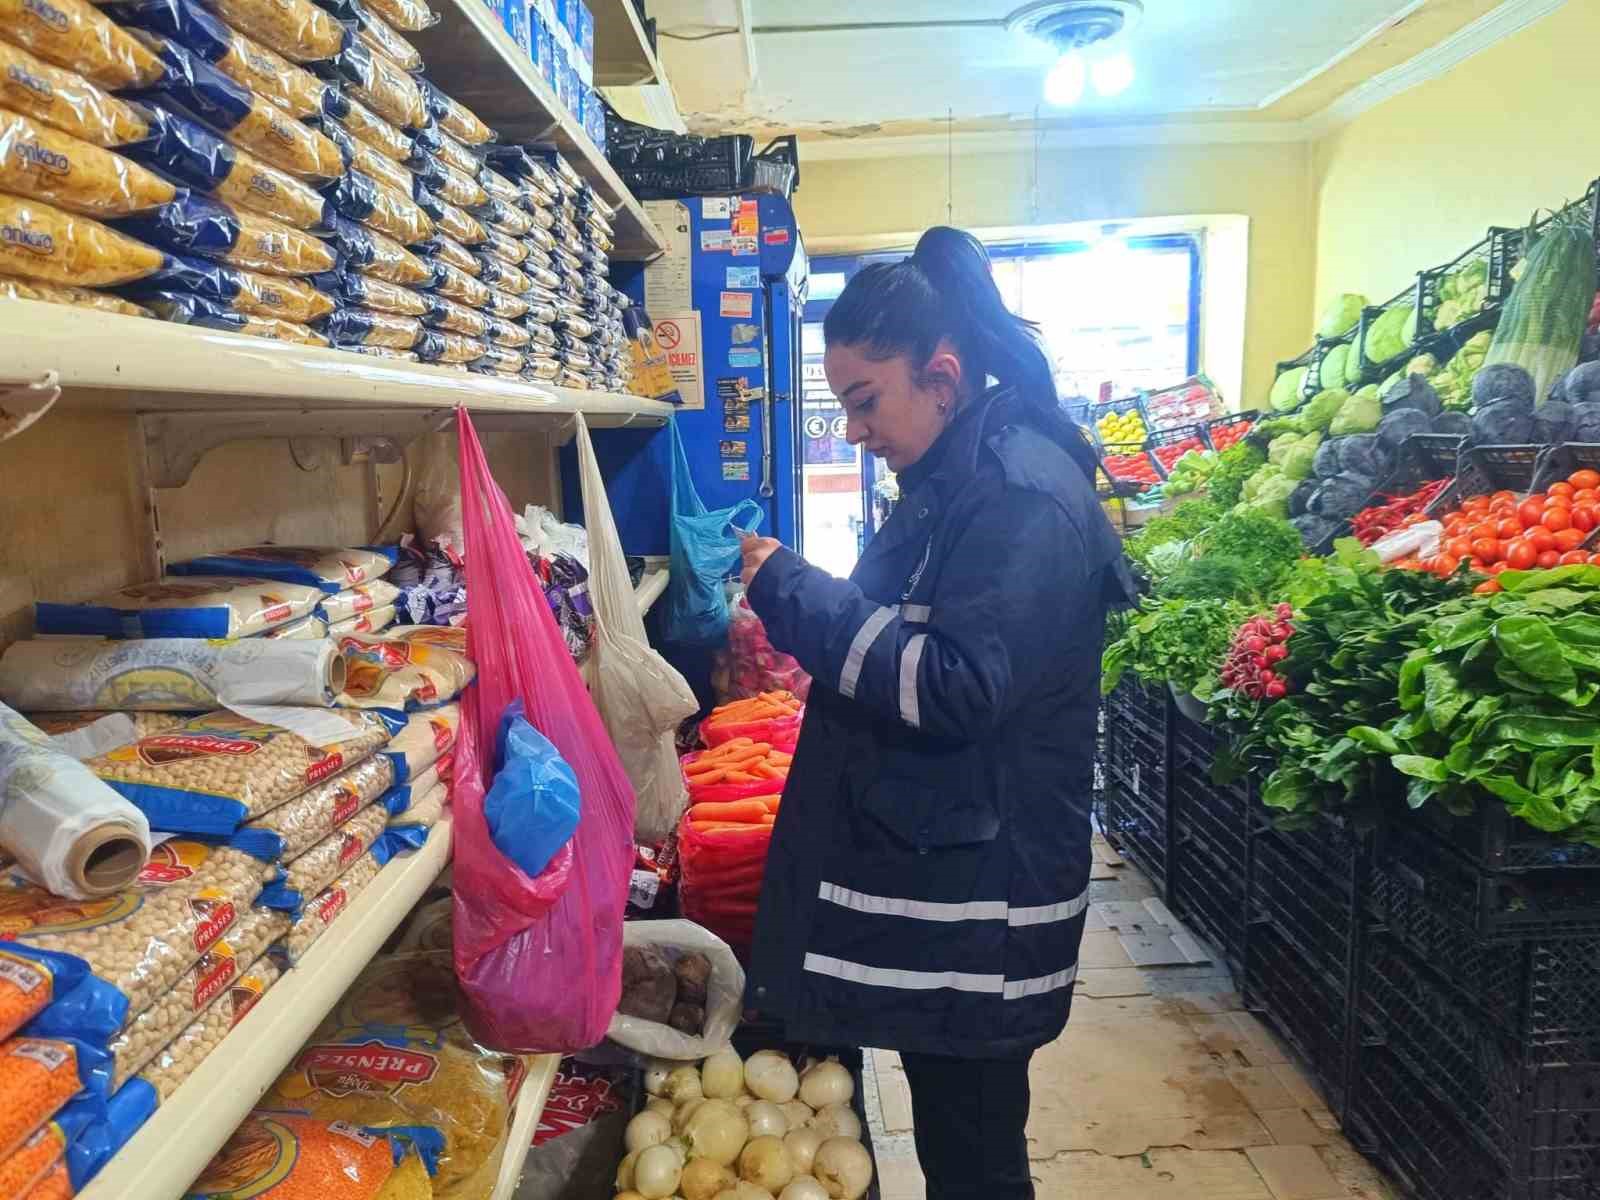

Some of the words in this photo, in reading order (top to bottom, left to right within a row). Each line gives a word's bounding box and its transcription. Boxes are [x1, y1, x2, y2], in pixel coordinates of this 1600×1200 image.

[1, 225, 52, 249] ankara
[198, 909, 232, 942] PRENSES
[198, 963, 232, 1004] PRENSES
[315, 1054, 423, 1074] PRENSES
